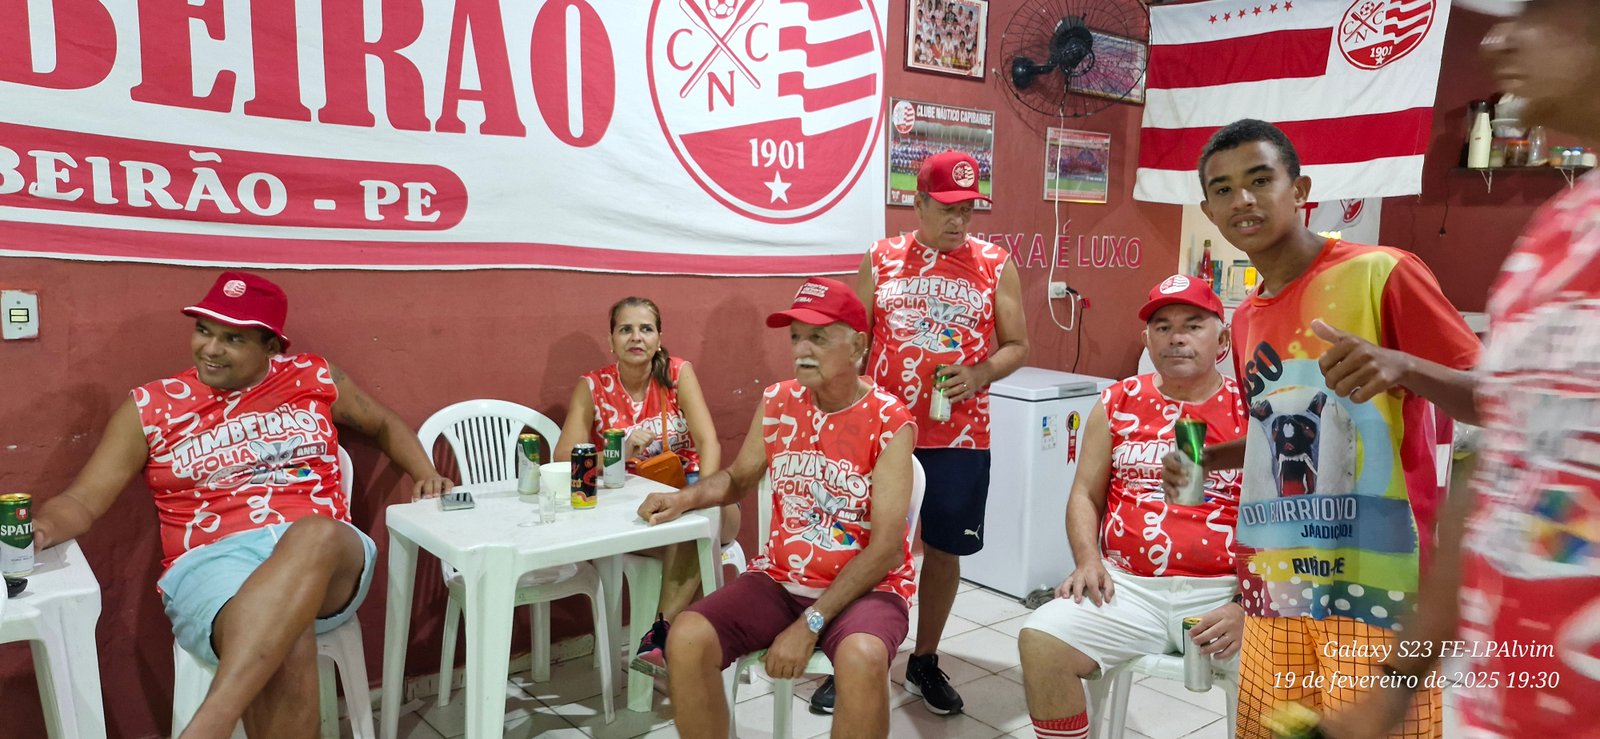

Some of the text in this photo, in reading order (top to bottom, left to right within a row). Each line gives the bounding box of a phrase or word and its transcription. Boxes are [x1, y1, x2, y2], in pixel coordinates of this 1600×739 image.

[1343, 11, 1384, 35] C C
[667, 22, 769, 71] C C
[1369, 46, 1393, 58] 1901
[708, 70, 736, 112] N
[916, 104, 936, 119] CLUBE
[749, 139, 805, 170] 1901
[359, 180, 441, 223] PE
[1077, 235, 1144, 269] LUXO
[877, 277, 984, 311] TIMBEIRÃO
[885, 297, 927, 312] FOLIA
[173, 402, 318, 468] TIMBEIRÃO
[191, 447, 256, 480] FOLIA
[1242, 503, 1267, 526] DO
